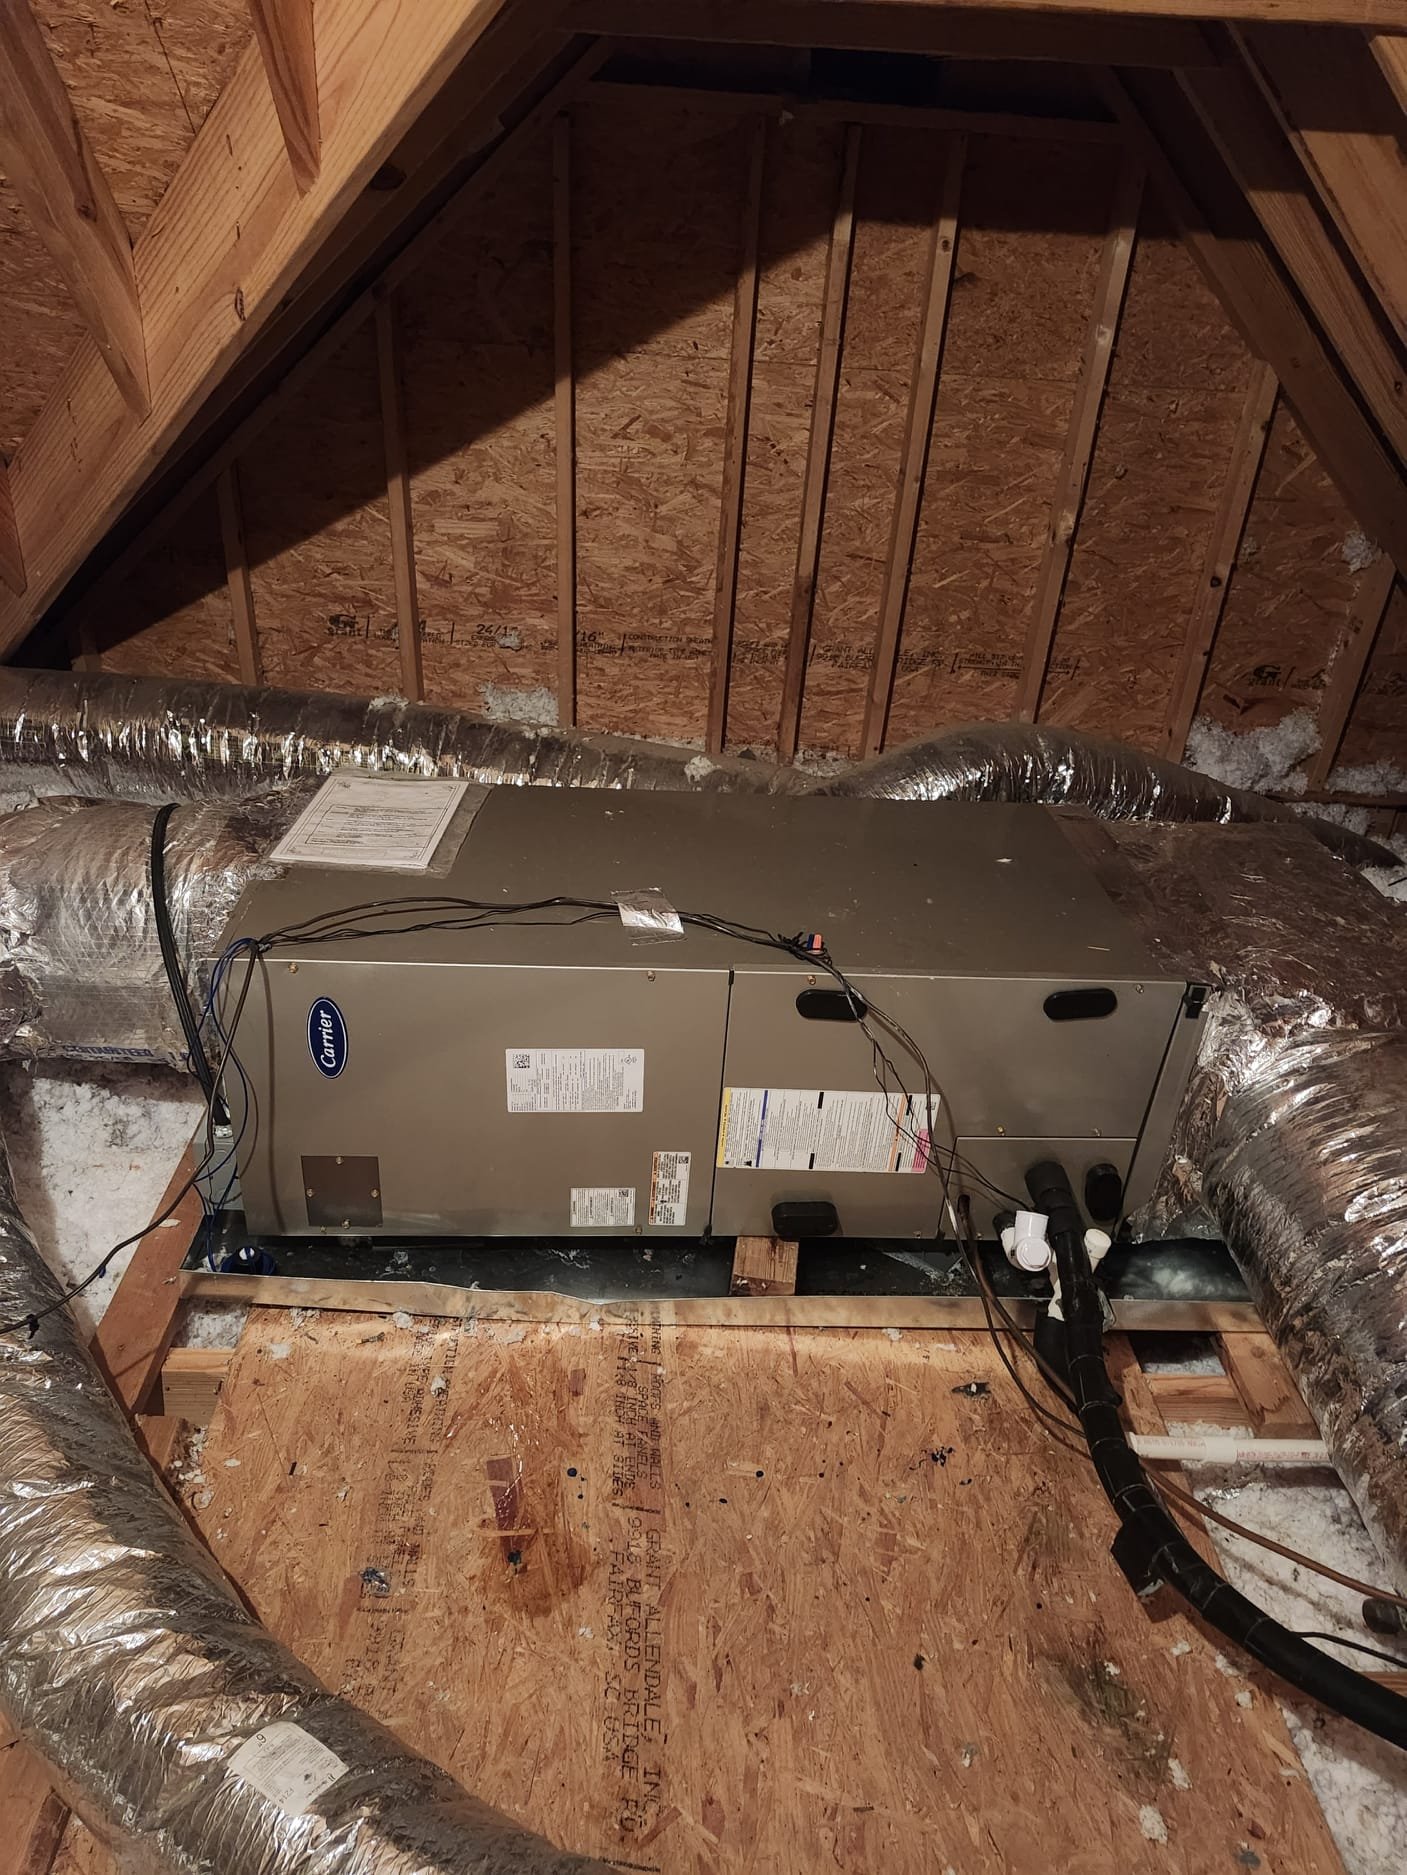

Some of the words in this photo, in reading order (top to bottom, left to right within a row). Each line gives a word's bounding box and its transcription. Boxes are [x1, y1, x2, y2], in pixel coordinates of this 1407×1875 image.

[476, 624, 519, 638] 24/1
[318, 1010, 336, 1068] Carrier
[615, 1393, 626, 1424] INCH
[625, 1396, 637, 1426] INCH
[637, 1385, 649, 1424] SPACE
[613, 1430, 625, 1447] AT
[625, 1432, 636, 1448] AT
[636, 1430, 648, 1480] PANELS
[612, 1454, 624, 1497] SIDES
[624, 1456, 636, 1490] ENDS
[649, 1448, 661, 1490] WALLS
[645, 1528, 662, 1590] GRANT
[624, 1577, 642, 1673] BUFORDS
[604, 1671, 622, 1701] SC
[641, 1603, 662, 1743] ALLENDALE,
[602, 1716, 620, 1761] USA
[621, 1688, 639, 1782] BRIDGE
